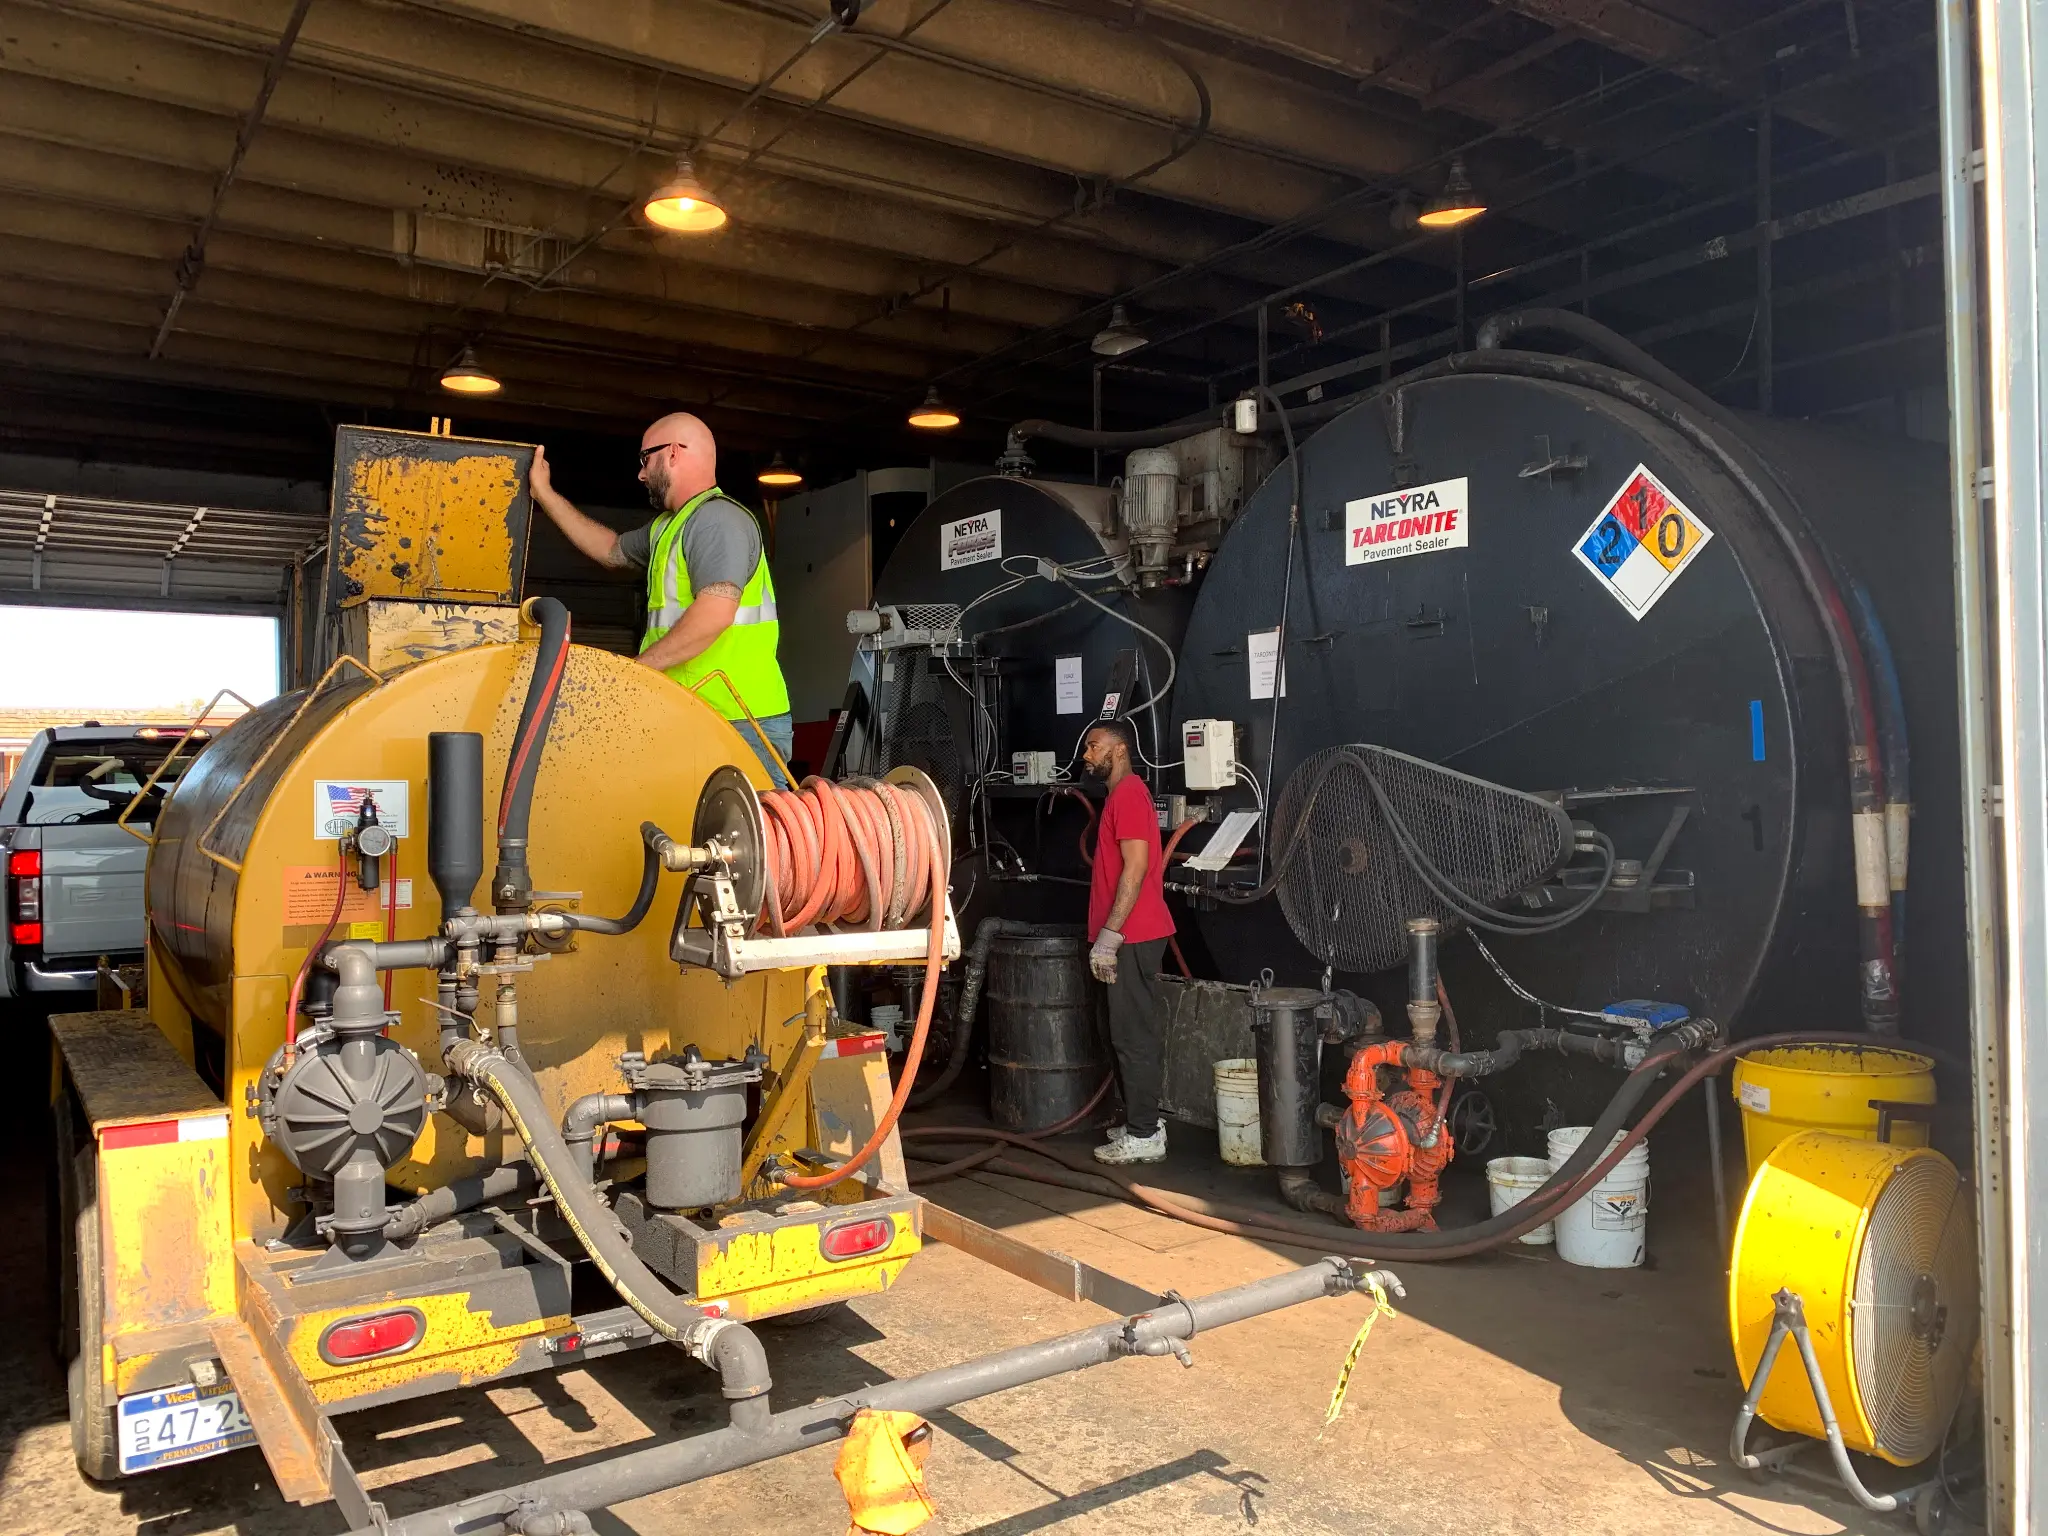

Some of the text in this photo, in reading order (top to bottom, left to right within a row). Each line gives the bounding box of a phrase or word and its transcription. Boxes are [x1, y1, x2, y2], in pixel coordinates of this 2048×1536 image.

[1371, 490, 1440, 520] NEYRA
[1631, 486, 1647, 530] 1
[954, 518, 988, 538] NEYRA
[1352, 509, 1459, 548] TARCONITE
[1658, 513, 1686, 559] 0
[1363, 536, 1449, 560] Pavement Sealer
[1598, 520, 1621, 565] 2
[950, 551, 993, 566] Pavement Sealer
[165, 1390, 197, 1404] West
[163, 1441, 215, 1460] PERMANENT
